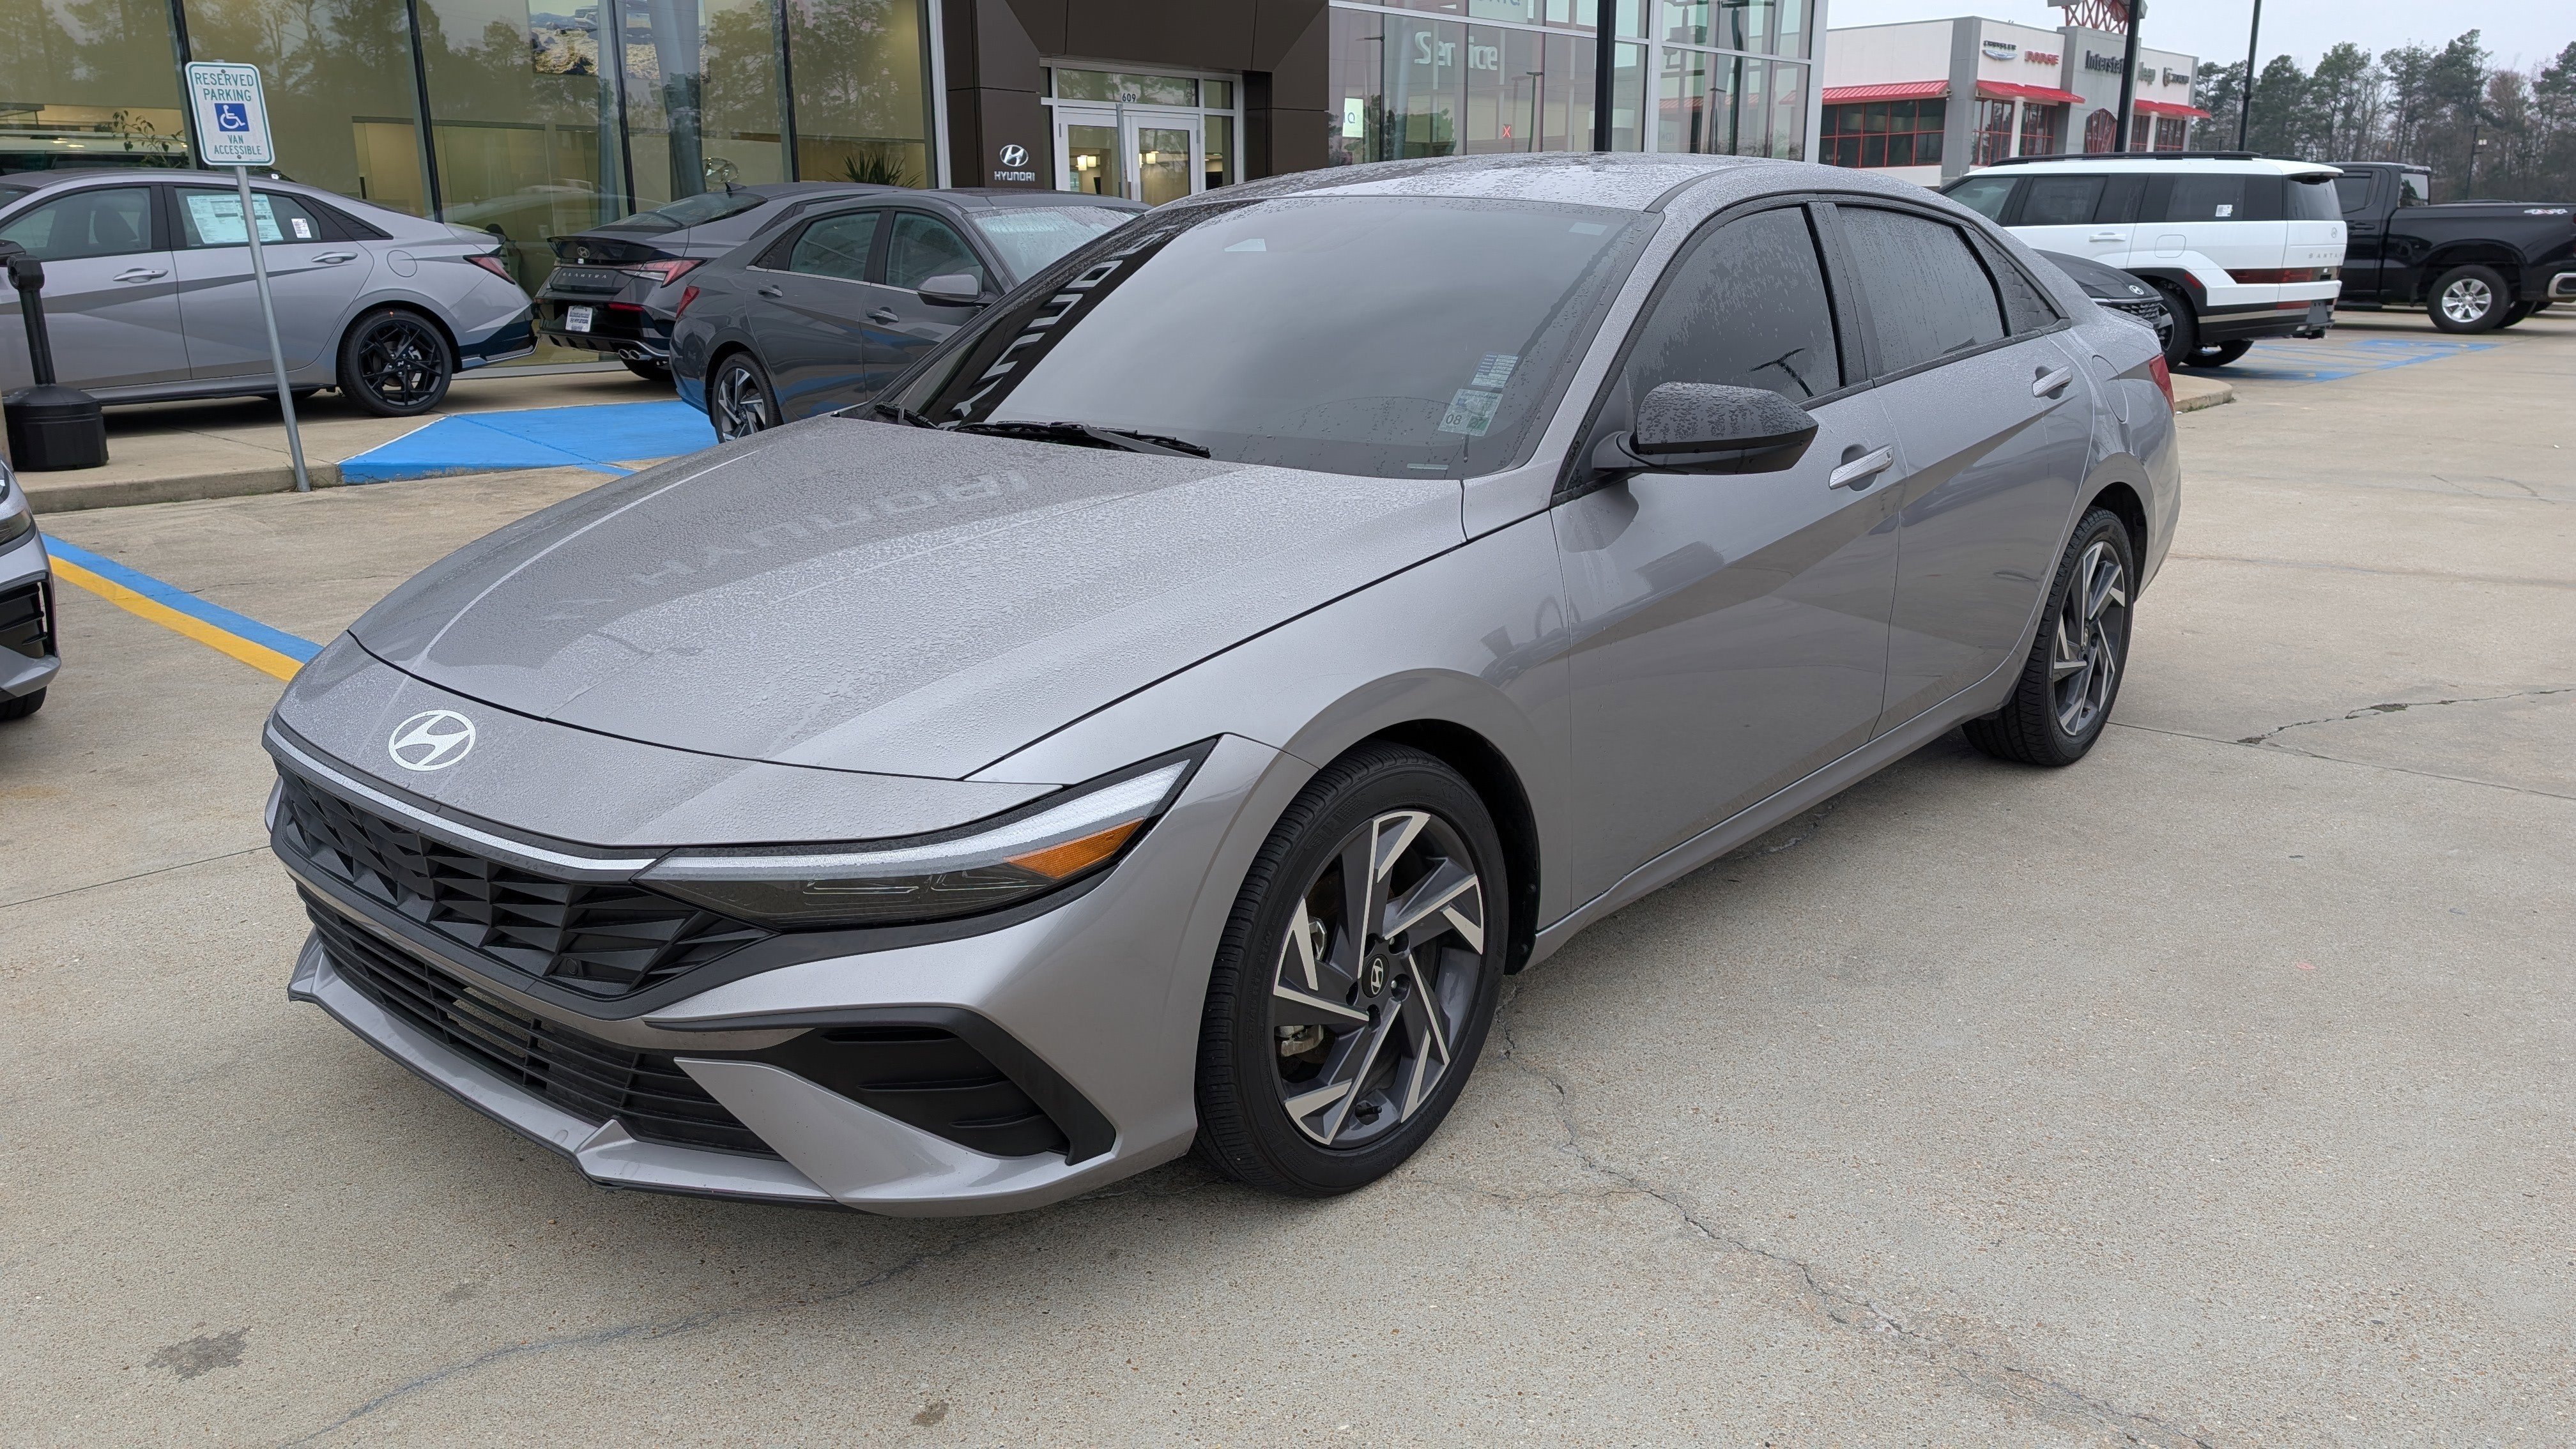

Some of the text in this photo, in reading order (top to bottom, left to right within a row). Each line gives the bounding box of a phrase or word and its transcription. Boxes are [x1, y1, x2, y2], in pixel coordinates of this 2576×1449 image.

[1413, 31, 1498, 70] Serice
[2085, 50, 2125, 73] Intersta
[194, 72, 254, 87] RESERVED
[203, 88, 252, 102] PARKING
[1122, 93, 1137, 102] 609
[227, 135, 244, 144] VAN
[214, 145, 262, 155] ACCESSIBLE
[993, 171, 1036, 181] HYUNDAI
[1445, 413, 1462, 425] 08
